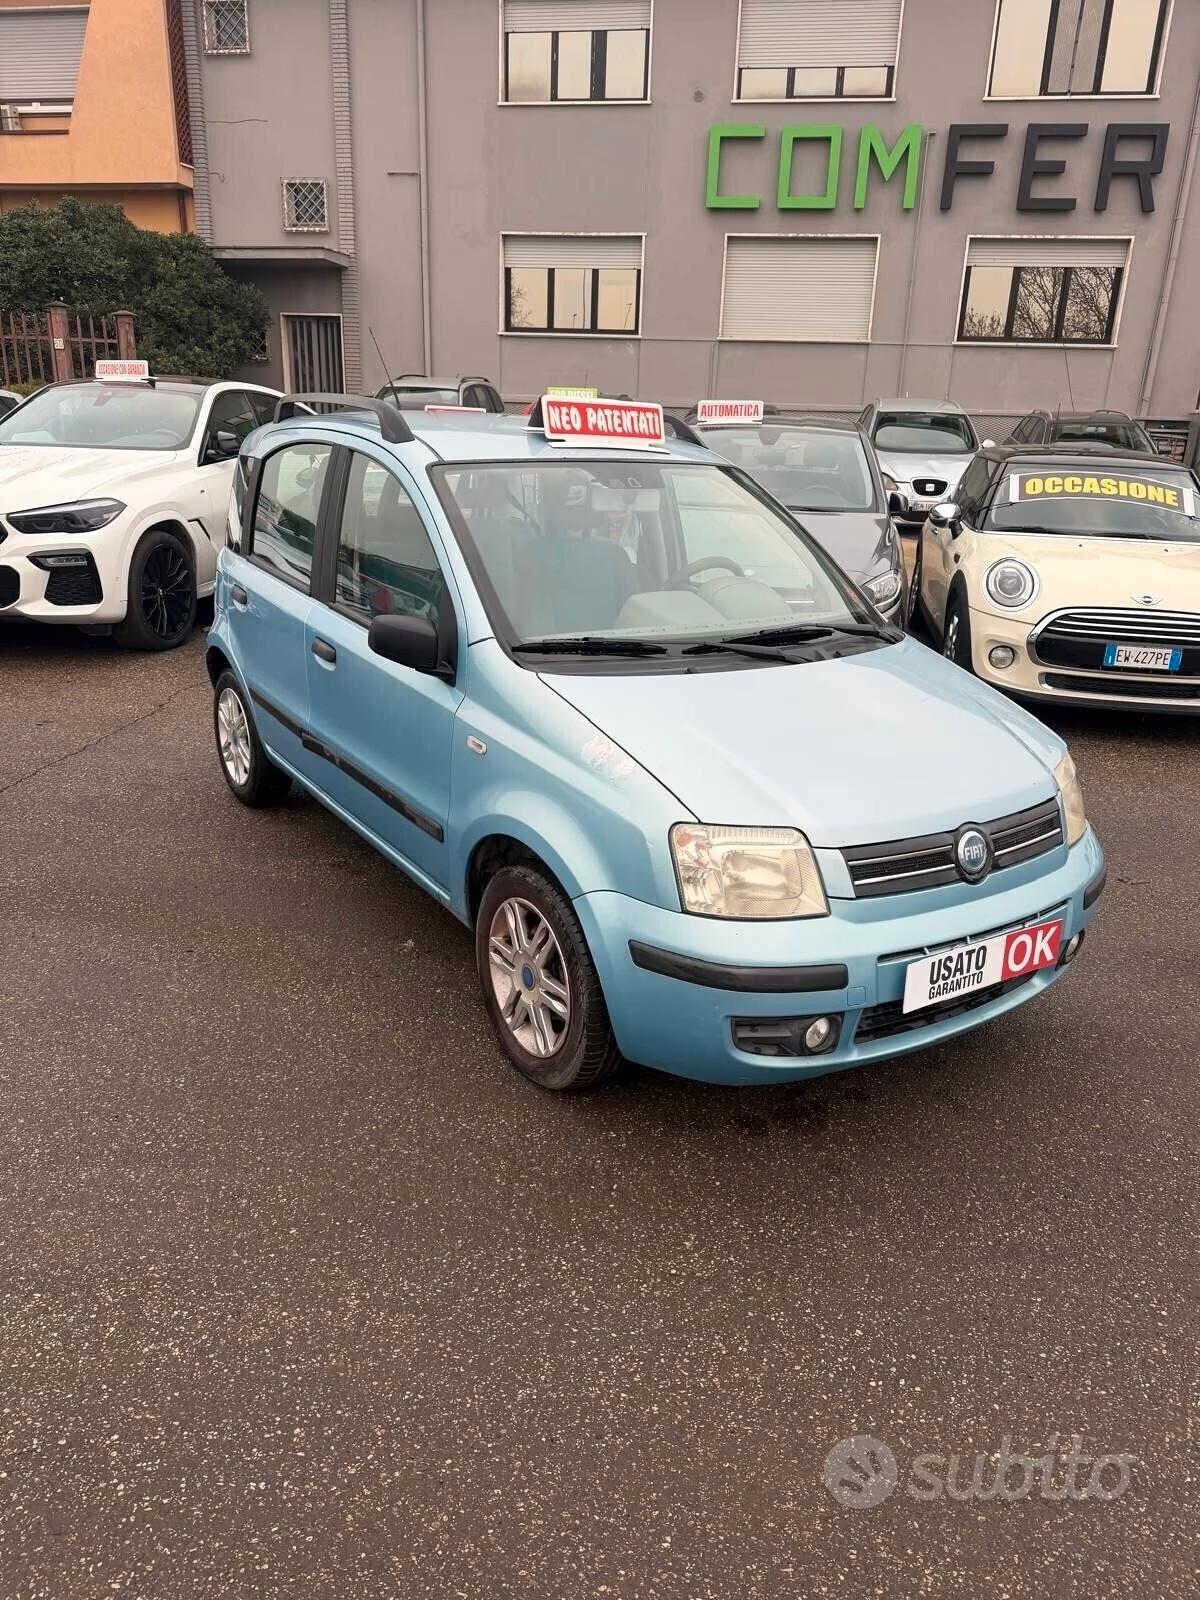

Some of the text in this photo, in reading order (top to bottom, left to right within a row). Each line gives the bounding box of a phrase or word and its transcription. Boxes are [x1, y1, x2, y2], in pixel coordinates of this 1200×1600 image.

[706, 123, 1170, 213] COMFER
[548, 405, 660, 436] NEO PATENTATI
[701, 404, 759, 417] AUTOMATICA
[1025, 476, 1179, 507] OCCASIONE
[964, 844, 984, 860] FIAT
[1008, 925, 1059, 972] OK
[929, 945, 987, 985] USATO
[928, 970, 984, 1000] GARANTITO
